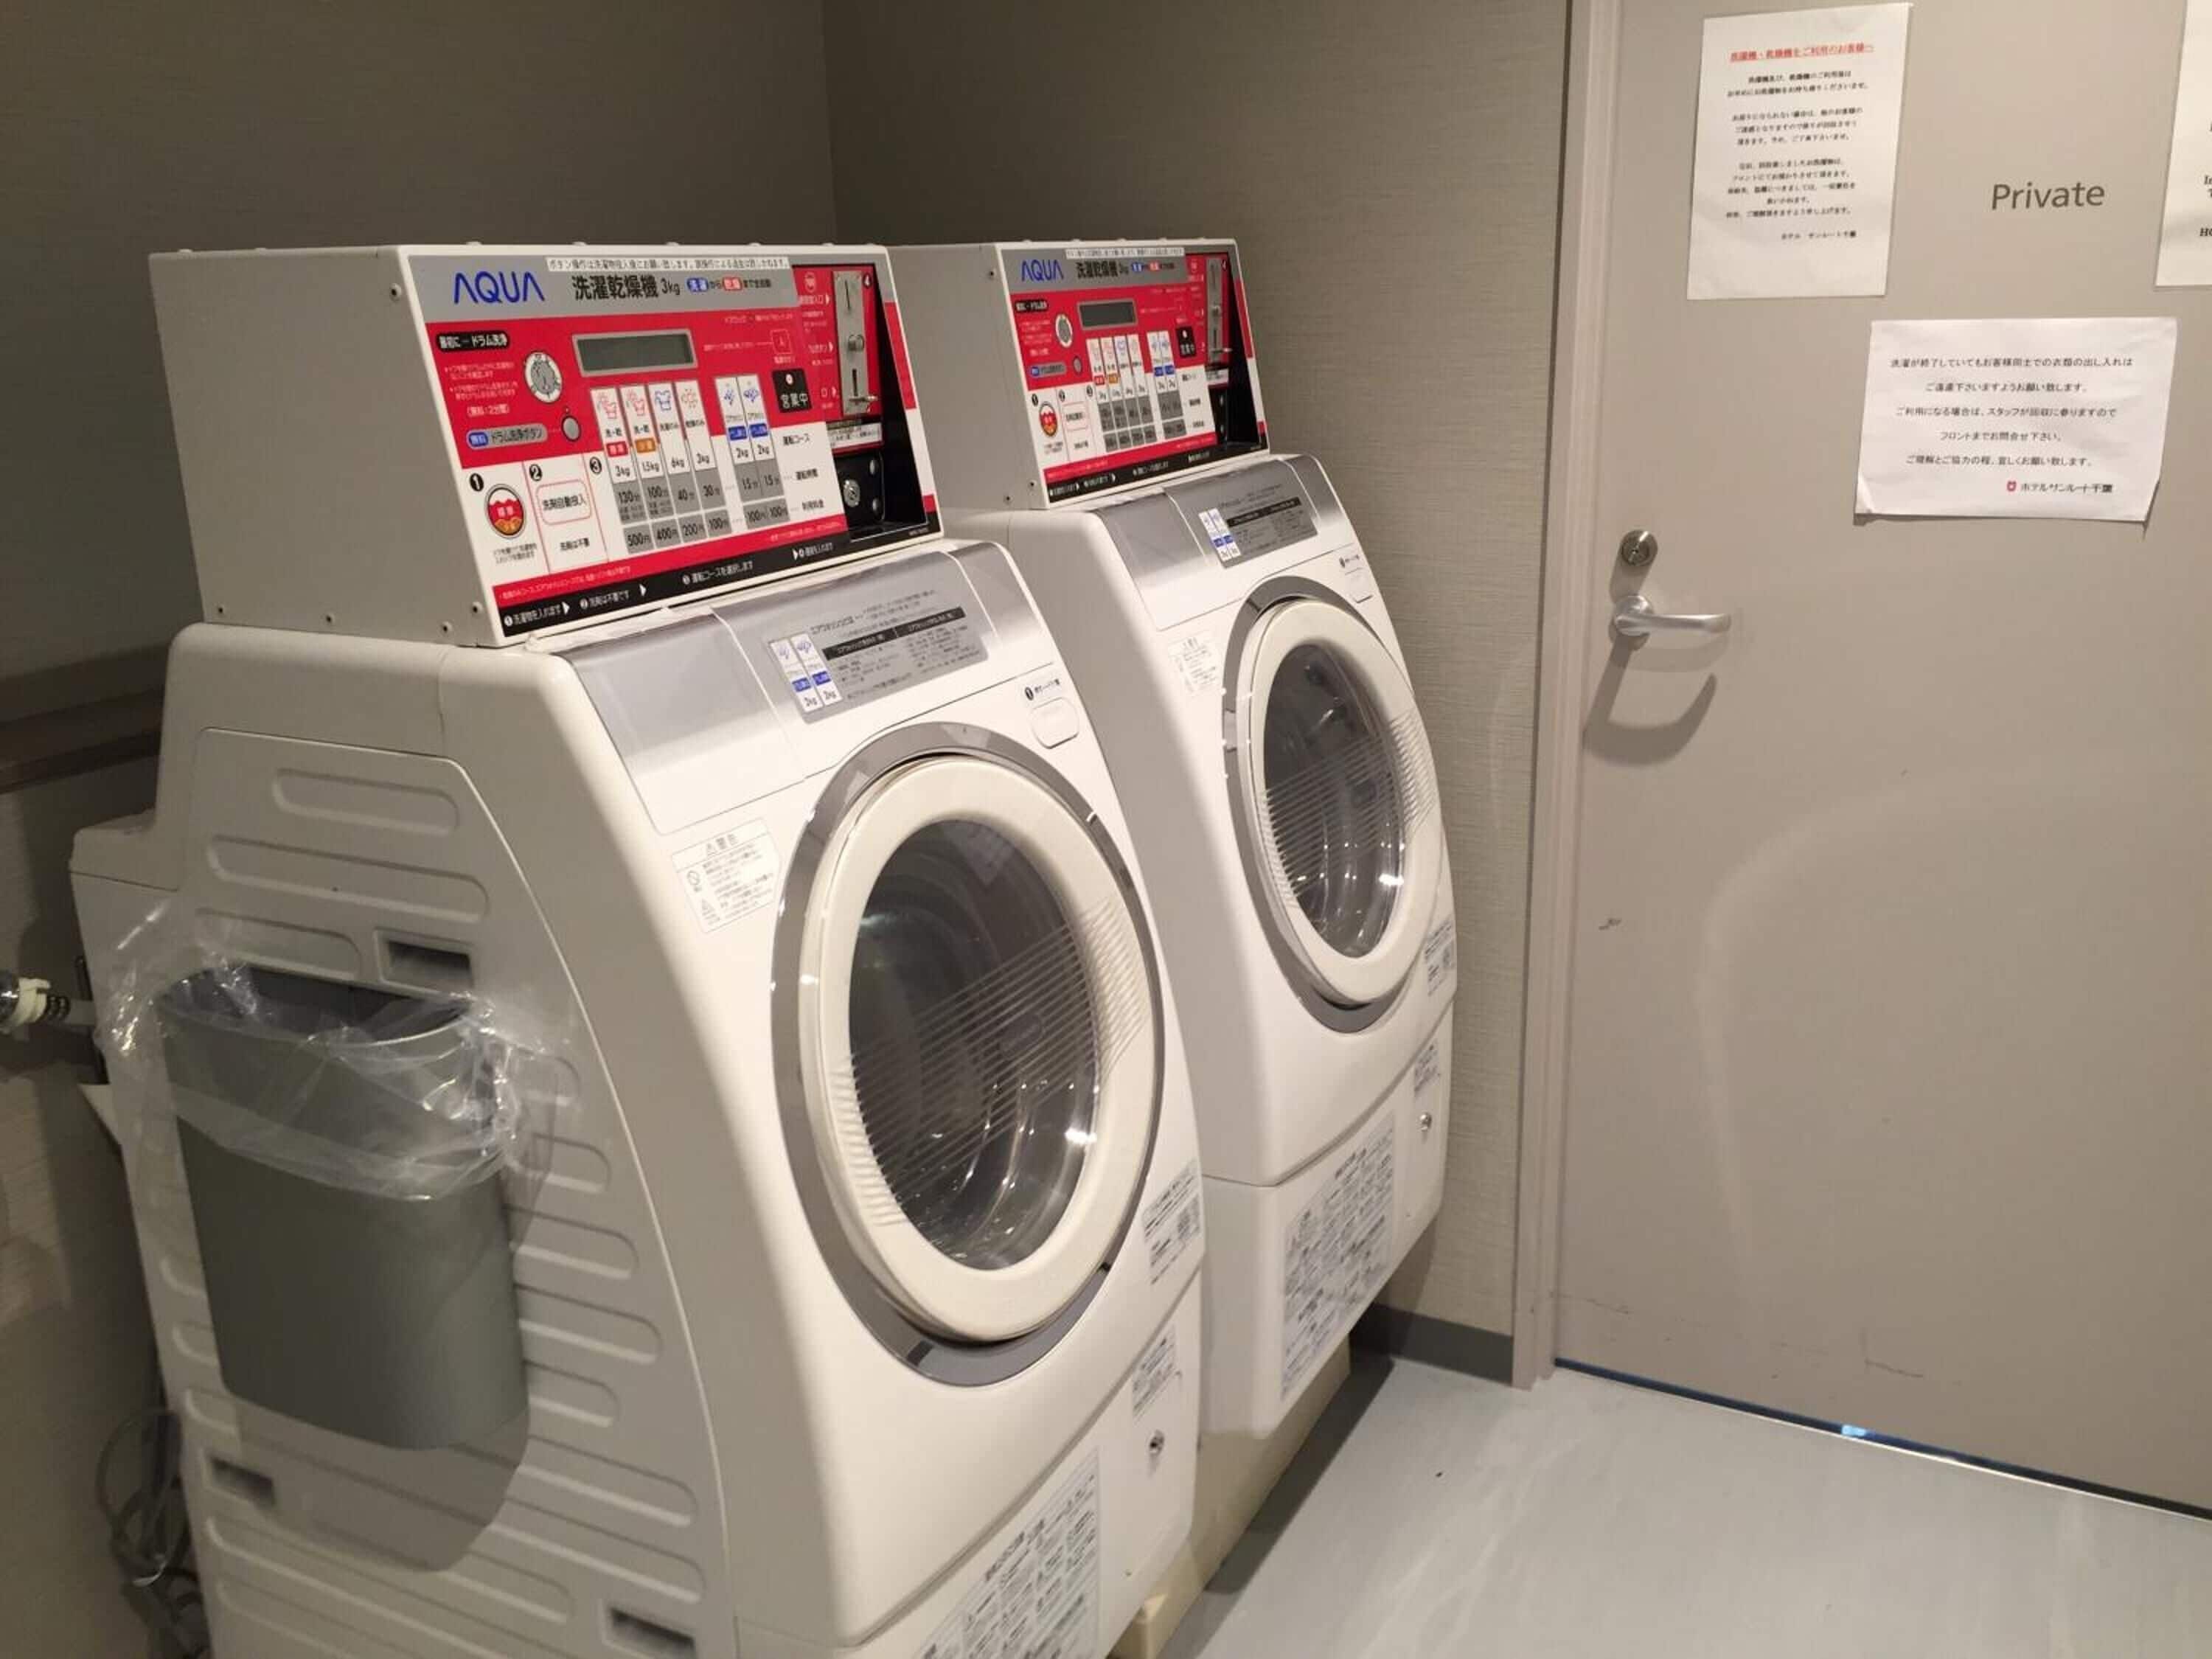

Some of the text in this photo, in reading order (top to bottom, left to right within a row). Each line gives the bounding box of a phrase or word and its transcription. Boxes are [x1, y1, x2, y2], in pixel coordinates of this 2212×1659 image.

[1992, 181, 2105, 210] Private
[1021, 259, 1064, 282] AQUA
[453, 271, 546, 305] AQUA
[571, 274, 681, 301] 洗濯乾燥機 3kg
